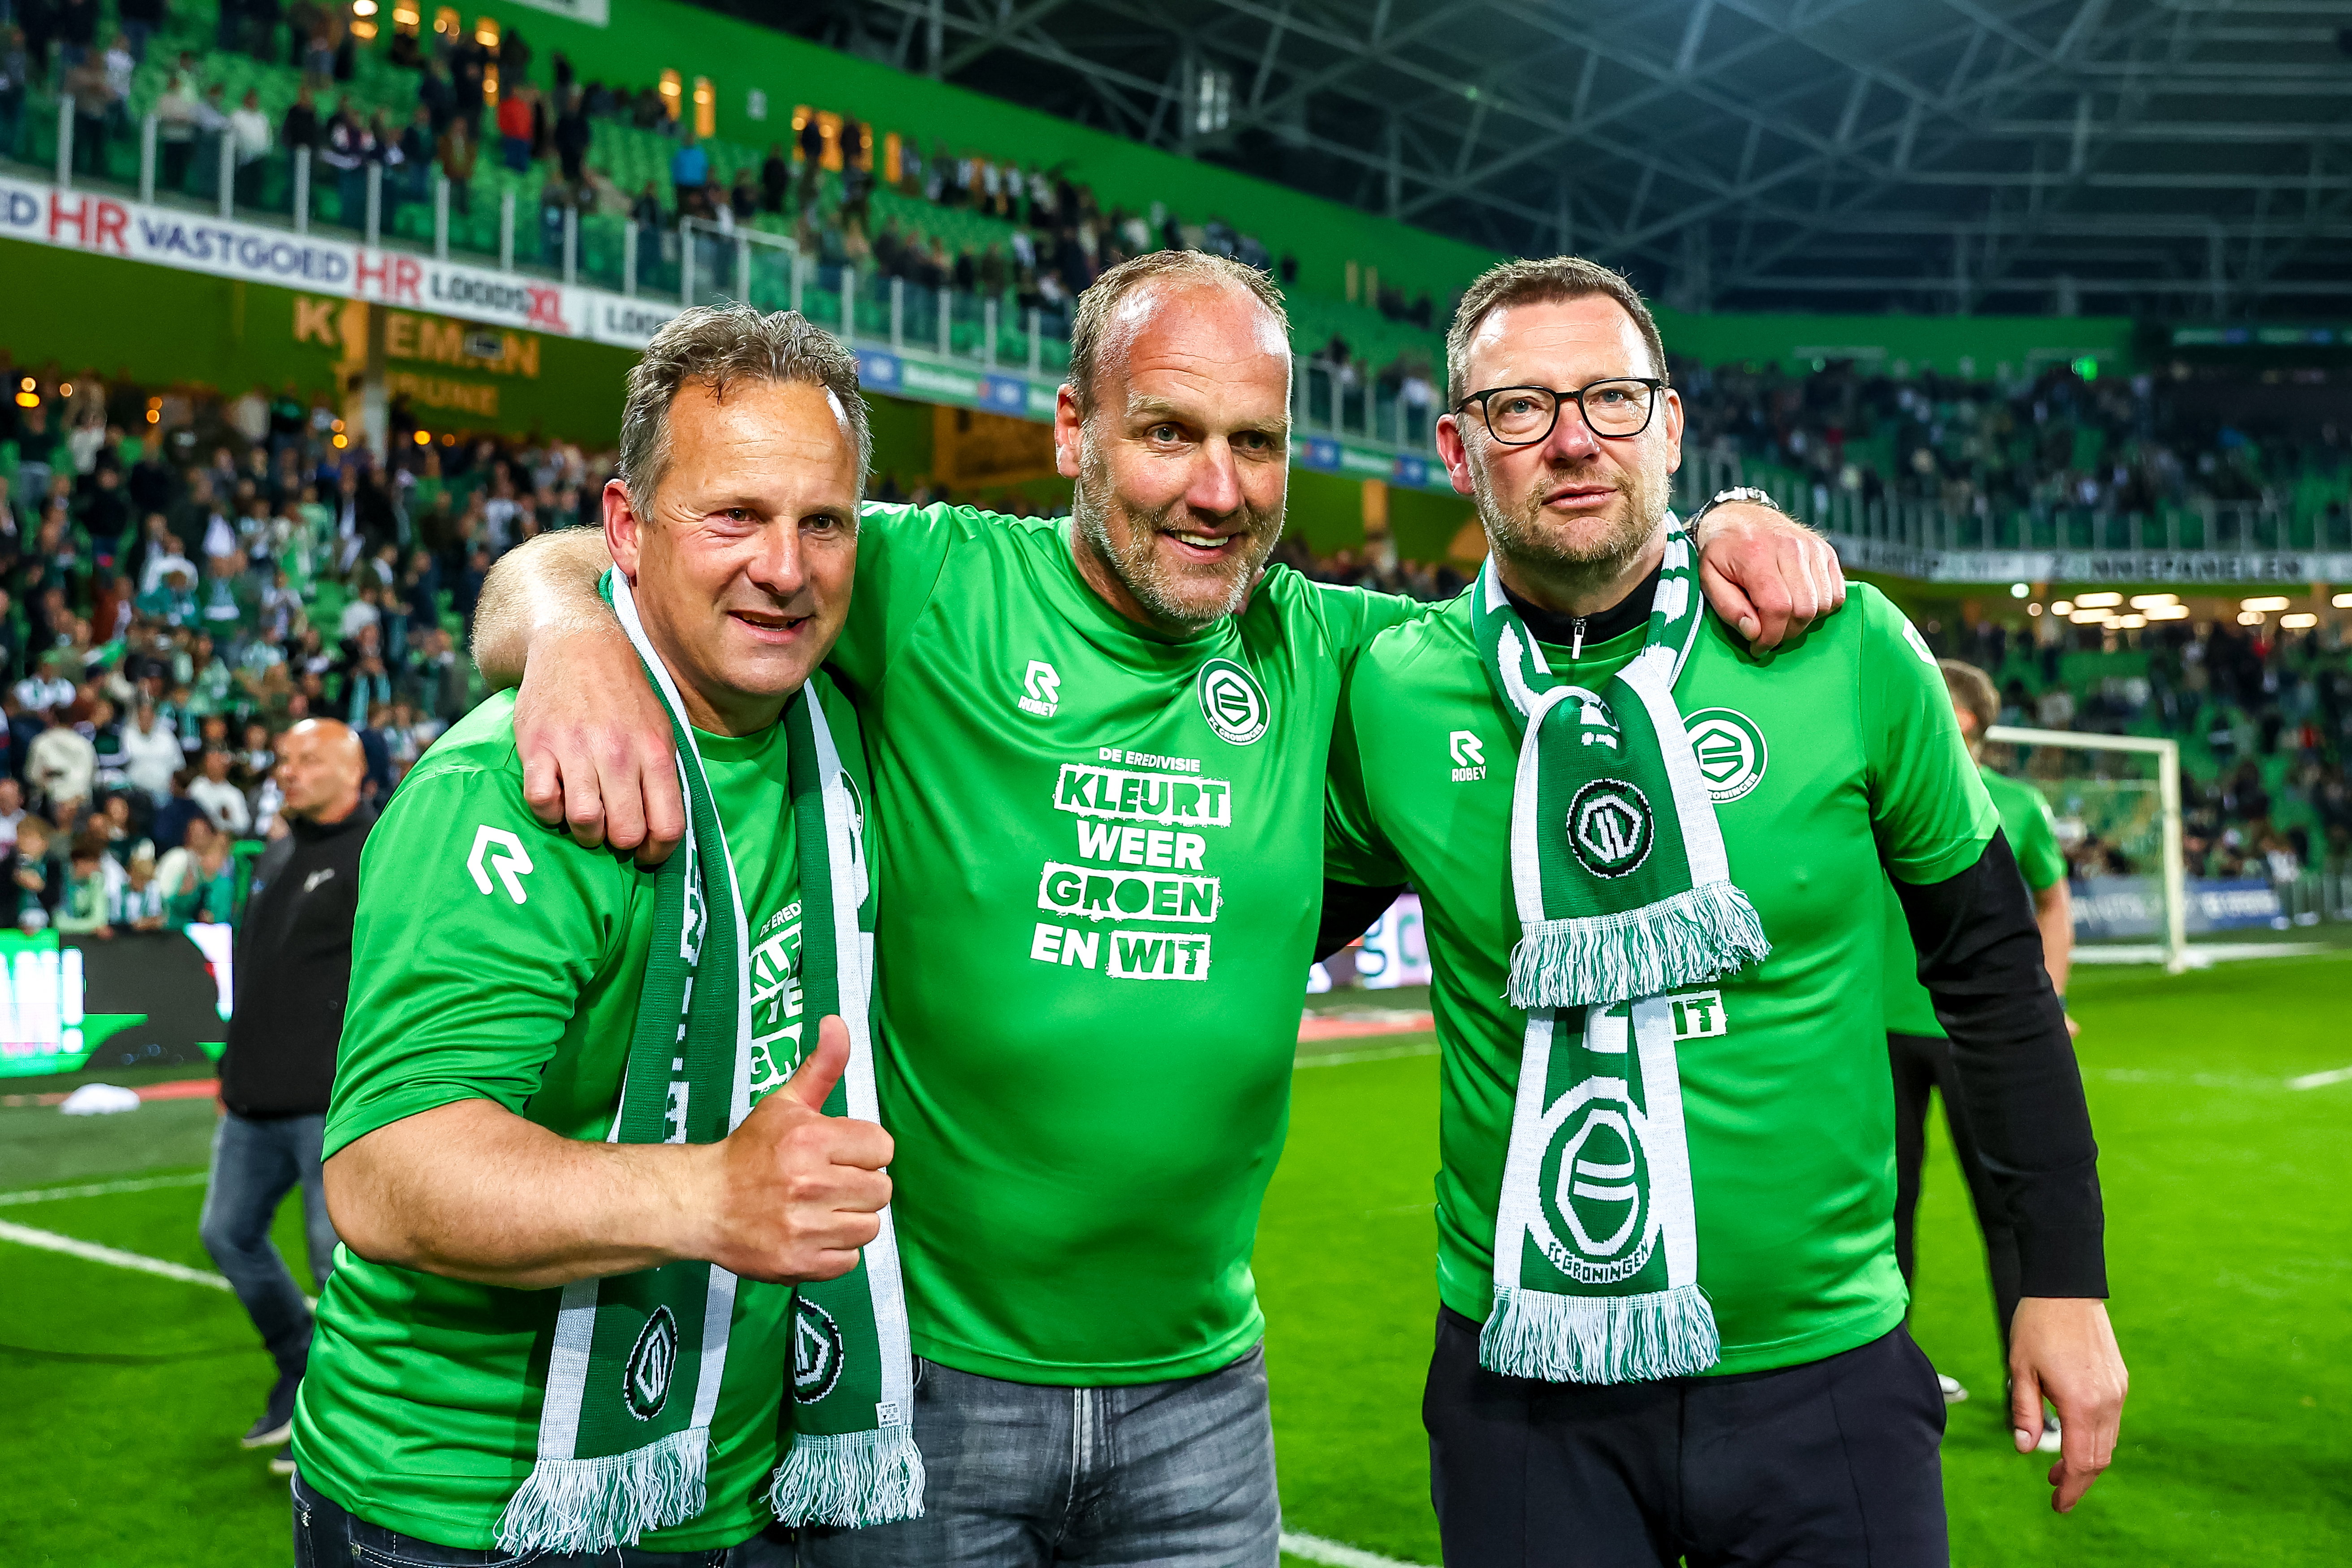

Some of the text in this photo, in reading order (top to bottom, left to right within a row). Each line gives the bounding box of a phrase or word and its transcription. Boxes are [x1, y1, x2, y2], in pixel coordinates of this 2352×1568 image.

[49, 192, 129, 256] HR
[138, 217, 349, 283] VASTGOED
[356, 247, 423, 306] HR
[1017, 695, 1059, 718] ROBEY
[1209, 716, 1264, 742] FC GRONINGEN
[1099, 747, 1201, 773] DE EREDIVISIE
[1451, 766, 1487, 782] ROBEY
[1060, 771, 1226, 818] KLEURT
[1707, 771, 1758, 800] RONINGEN
[1076, 819, 1206, 870] WEER
[1046, 870, 1214, 917] GROEN
[759, 899, 802, 938] DE ERED
[1030, 922, 1207, 975] EN WIT
[1667, 997, 1717, 1035] IT
[1548, 1239, 1649, 1282] FC GRONINGEN
